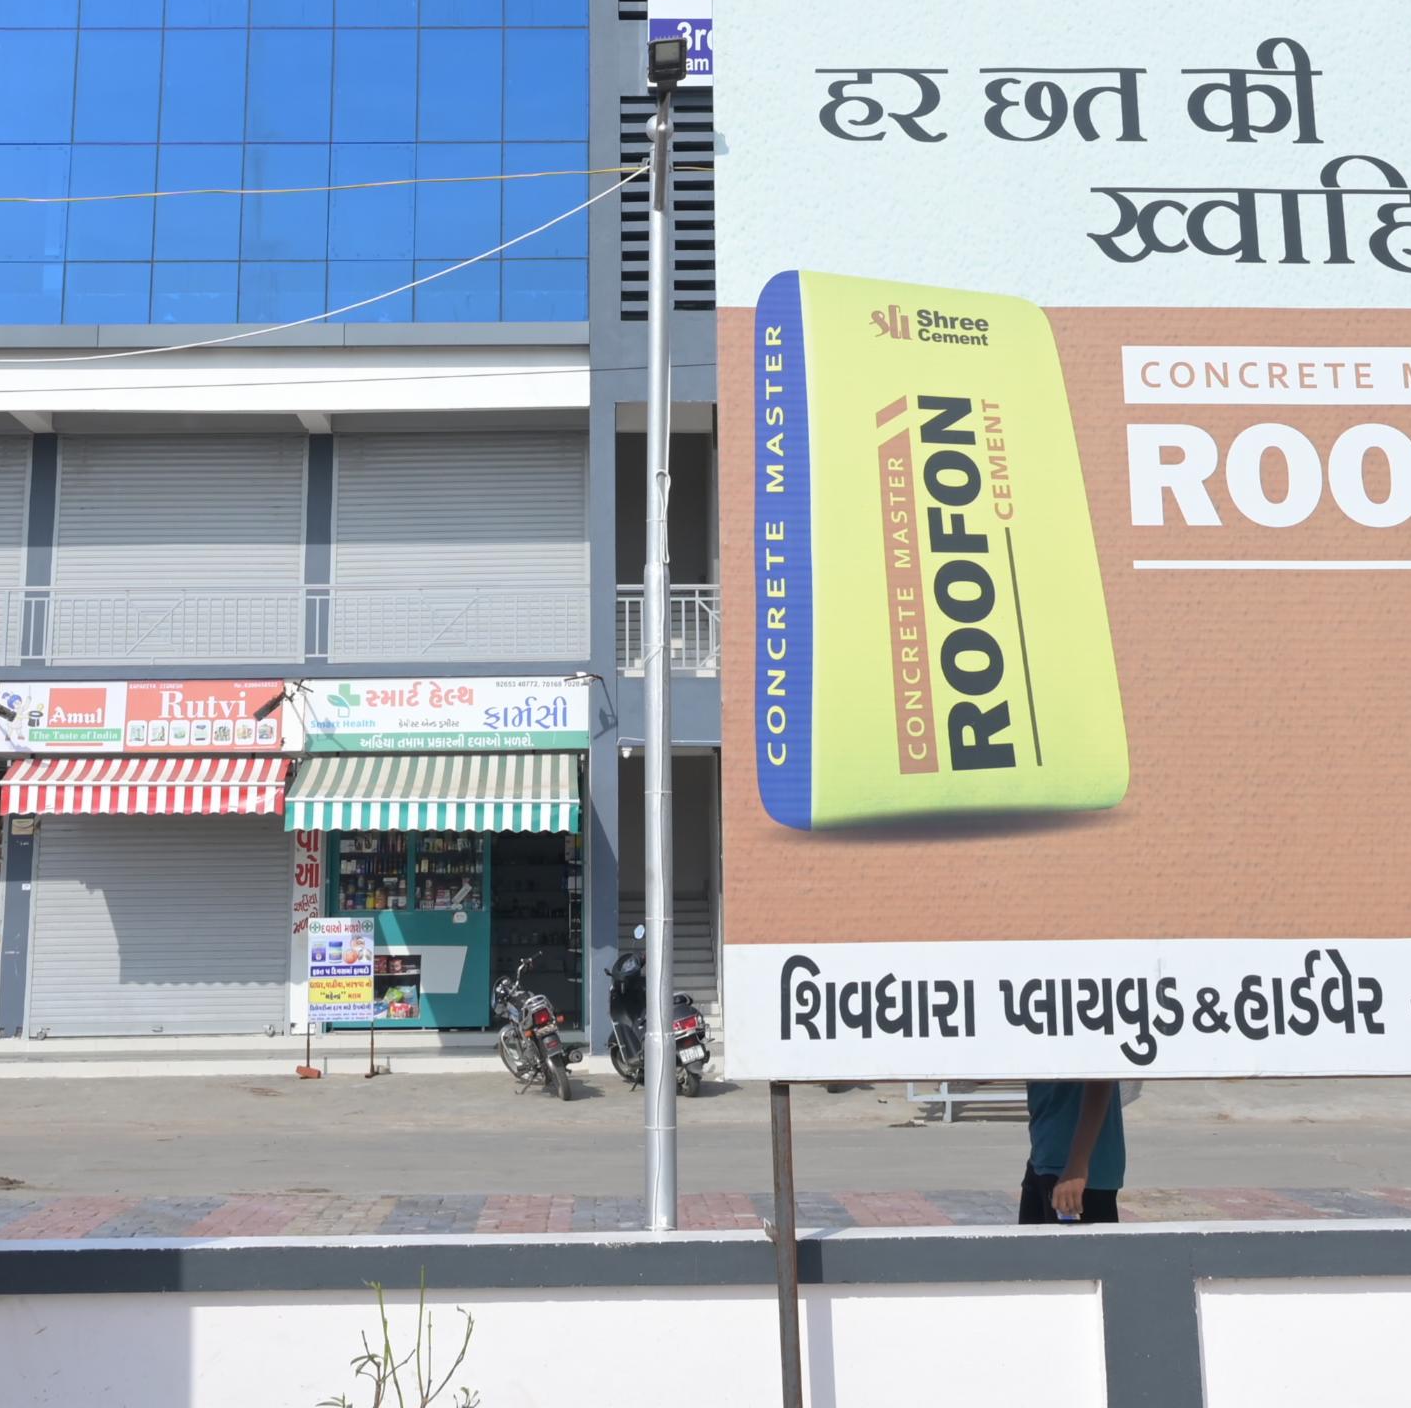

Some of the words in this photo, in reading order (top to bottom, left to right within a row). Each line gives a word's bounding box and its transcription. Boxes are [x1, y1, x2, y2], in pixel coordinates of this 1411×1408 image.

[815, 67, 949, 143] हर
[980, 67, 1147, 143] छत
[1182, 36, 1324, 144] की
[916, 308, 990, 332] Shree
[917, 328, 989, 347] Cement
[1140, 361, 1374, 389] CONCRETE
[766, 324, 784, 493] MASTER
[981, 398, 1014, 521] CEMENT
[887, 456, 912, 568] MASTER
[917, 395, 1017, 772] ROOFON
[766, 519, 787, 765] CONCRETE
[898, 586, 928, 760] CONCRETE
[158, 690, 249, 719] Rutvi
[365, 681, 422, 707] સ્માર્ટ
[428, 681, 474, 708] હેલ્થ
[49, 706, 103, 725] Amul
[310, 720, 340, 729] Smart
[342, 719, 376, 728] Health
[483, 696, 568, 730] ફાર્મસી
[32, 731, 49, 740] The
[52, 731, 78, 740] Taste
[80, 731, 90, 740] of
[92, 731, 118, 740] India
[397, 736, 424, 748] તમામ
[467, 733, 500, 747] દવાઓ
[780, 954, 975, 1040] શિવધારા
